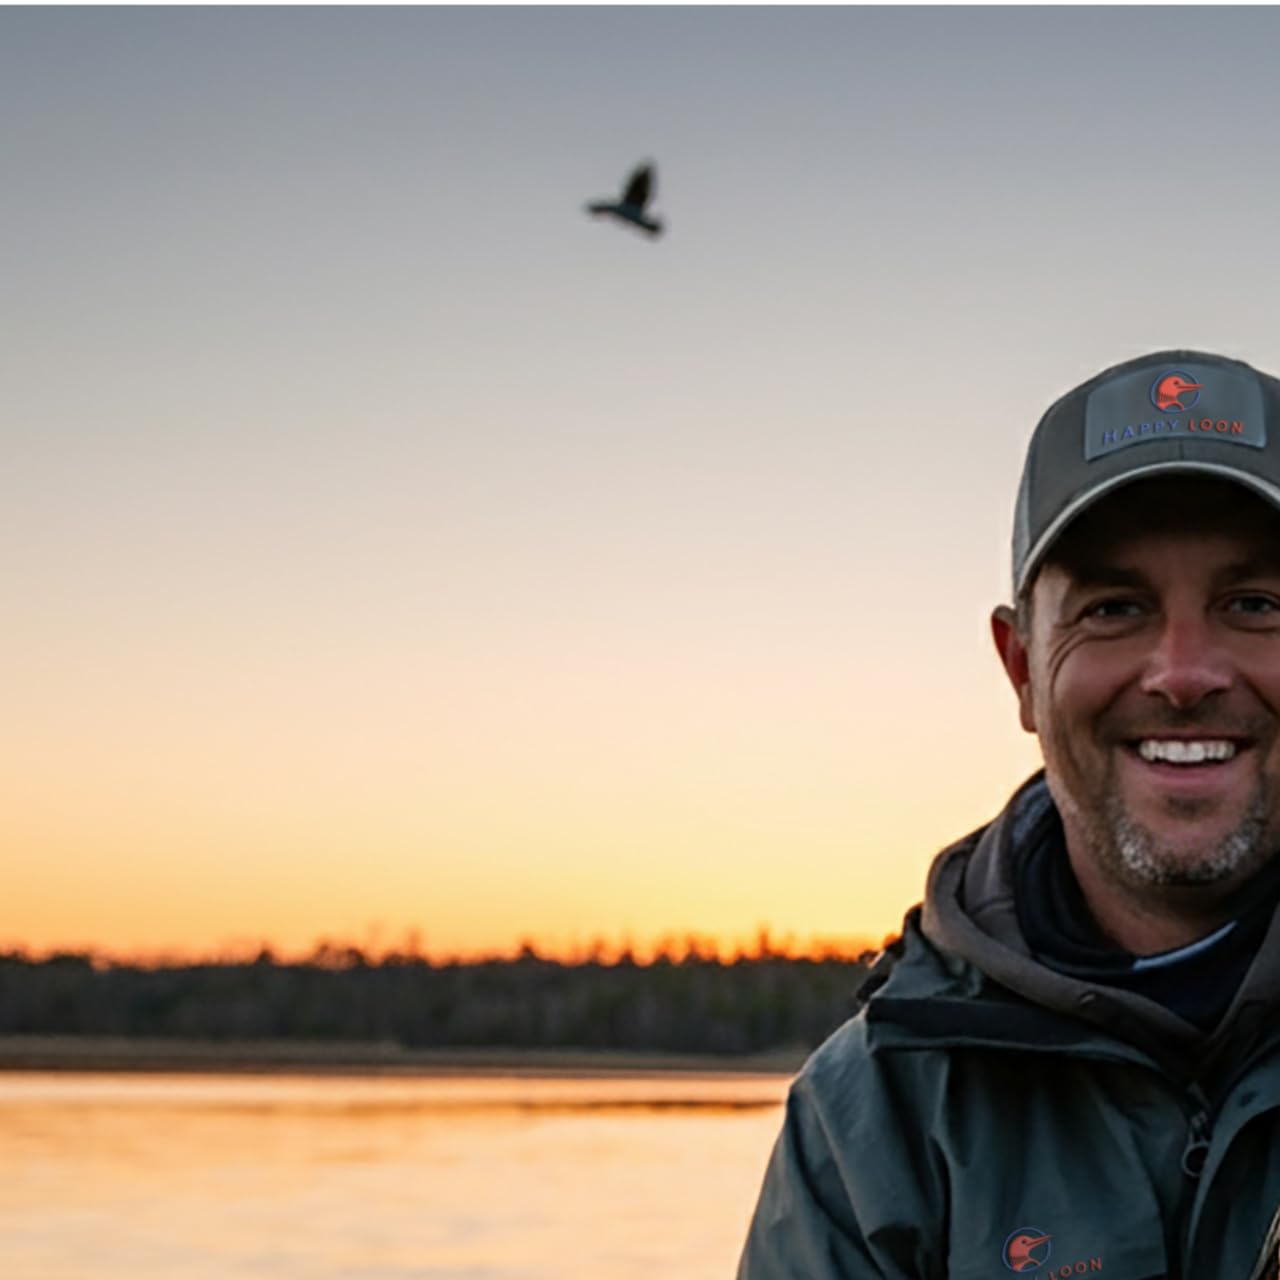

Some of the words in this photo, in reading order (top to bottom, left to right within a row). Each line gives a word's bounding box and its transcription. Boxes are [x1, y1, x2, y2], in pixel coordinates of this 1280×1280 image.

[1103, 419, 1179, 447] HAPPY
[1188, 417, 1244, 436] LOON
[1048, 1257, 1103, 1280] LOON
